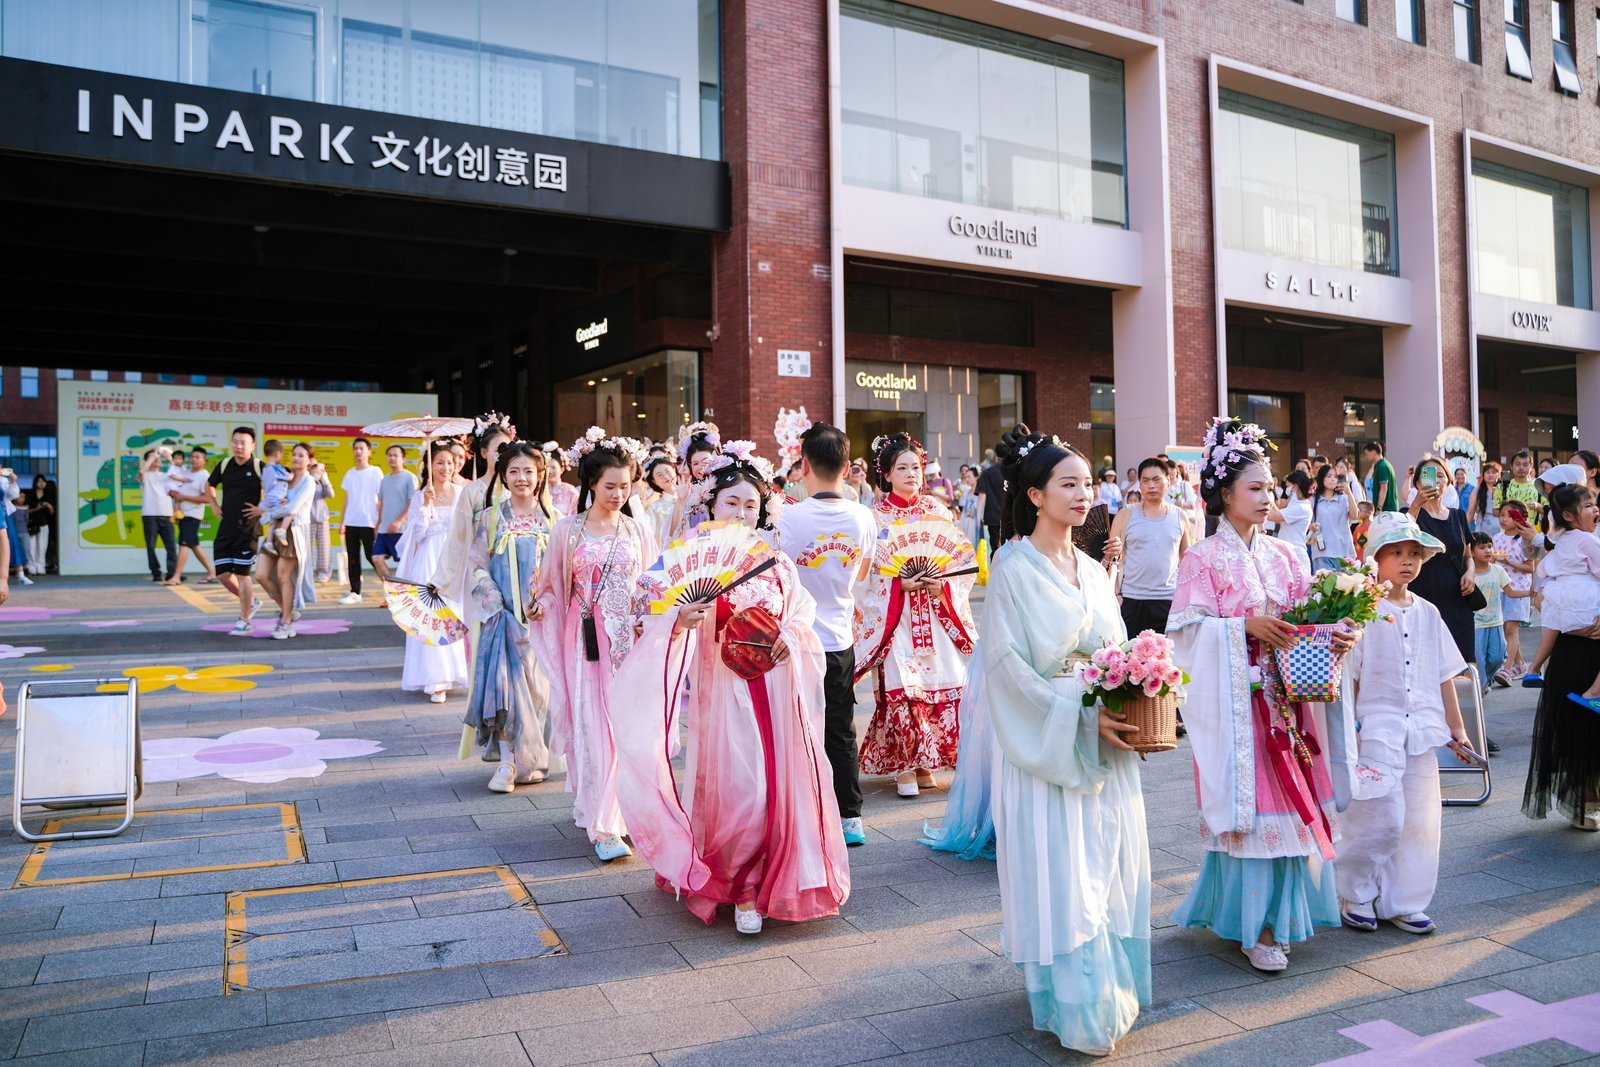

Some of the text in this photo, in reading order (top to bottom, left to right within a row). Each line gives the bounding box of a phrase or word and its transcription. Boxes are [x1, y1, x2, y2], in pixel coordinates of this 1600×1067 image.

[77, 88, 568, 193] INPARK 文化创意园
[949, 215, 1038, 248] Goodland
[575, 317, 608, 343] Goodland
[787, 364, 794, 374] 5
[855, 371, 917, 390] Goodland
[168, 398, 348, 417] 嘉年华联合宠粉商户活动导览图
